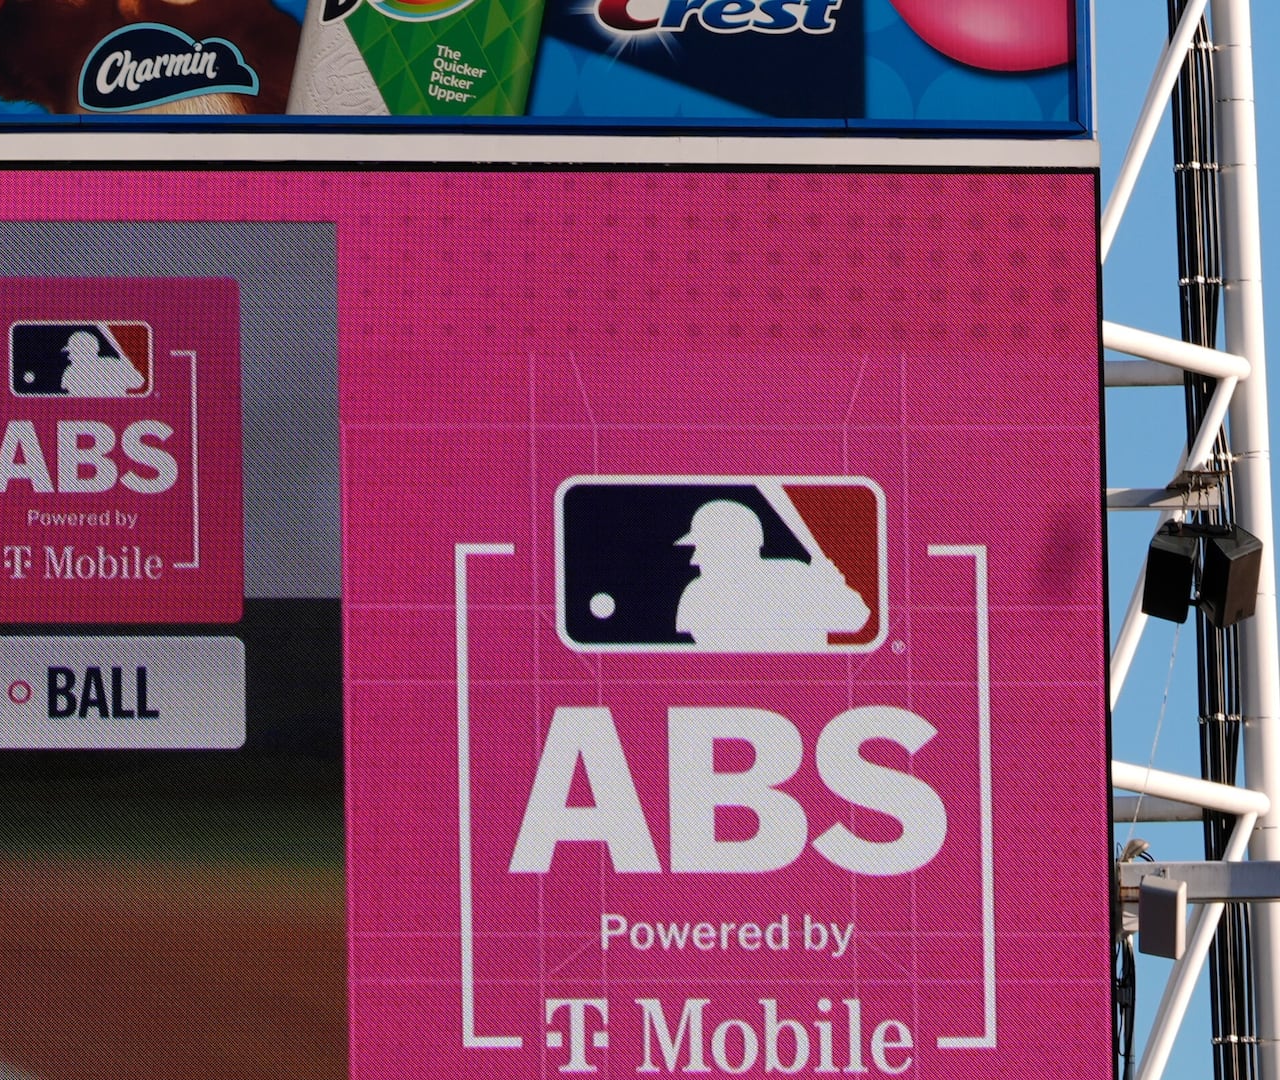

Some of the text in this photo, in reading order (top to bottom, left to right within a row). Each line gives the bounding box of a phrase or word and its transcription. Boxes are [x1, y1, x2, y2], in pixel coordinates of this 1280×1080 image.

[96, 43, 217, 95] Charmin
[433, 58, 487, 78] Quicker
[436, 44, 461, 61] The
[430, 71, 474, 90] Picker
[27, 510, 138, 530] Powered by
[44, 546, 163, 580] Mobile
[47, 666, 160, 719] BALL
[508, 705, 948, 876] ABS
[601, 914, 855, 957] Powered by
[635, 997, 914, 1075] Mobile
